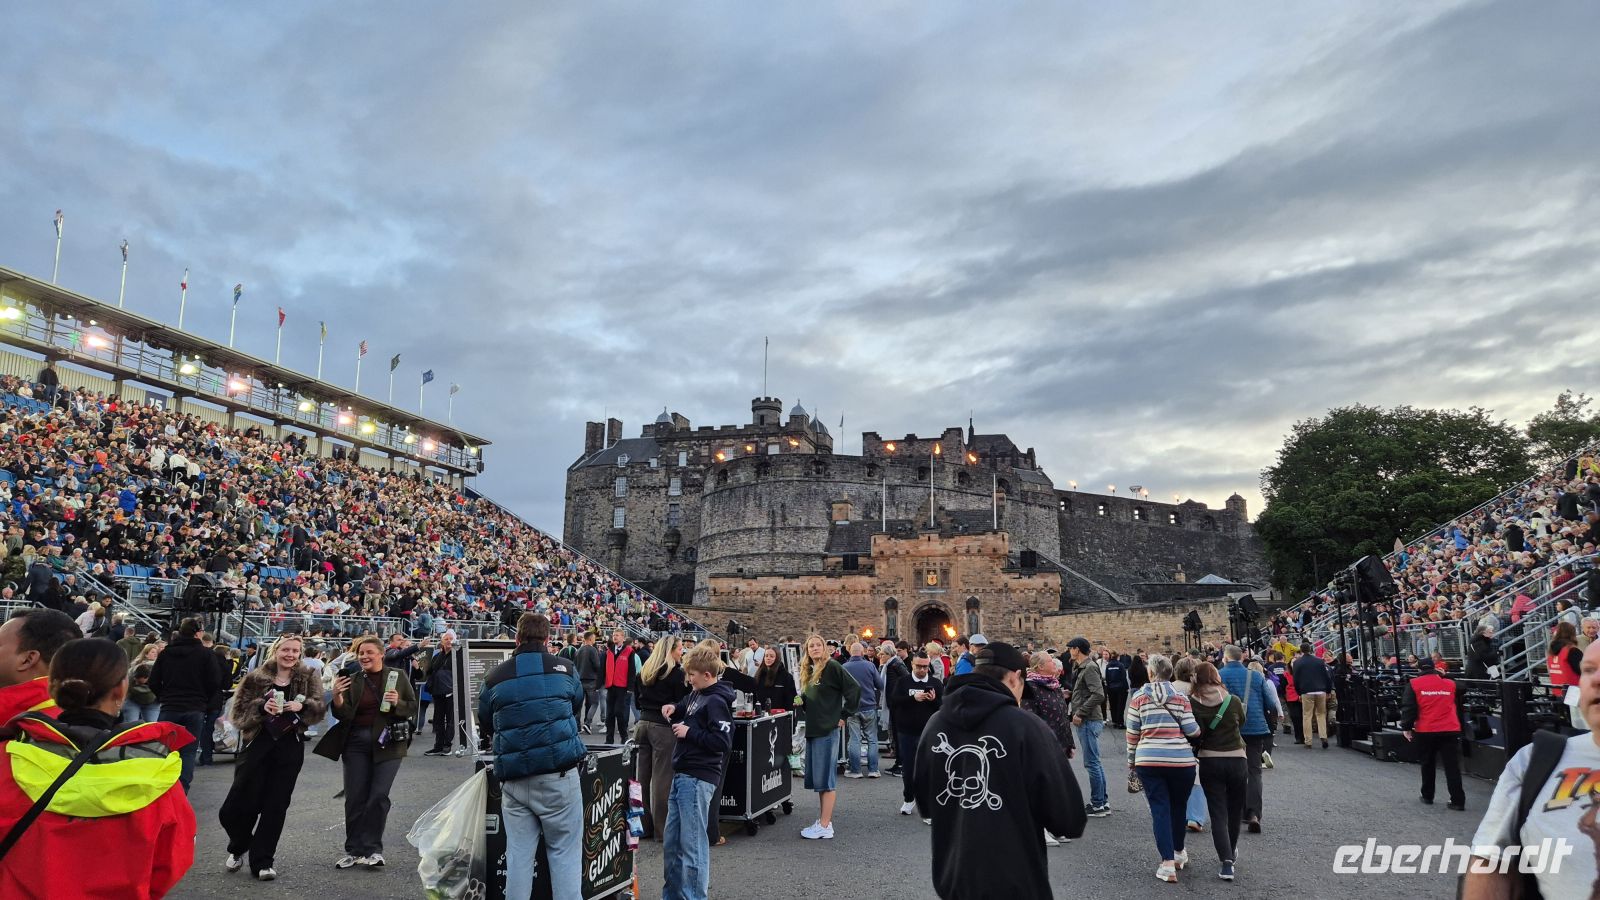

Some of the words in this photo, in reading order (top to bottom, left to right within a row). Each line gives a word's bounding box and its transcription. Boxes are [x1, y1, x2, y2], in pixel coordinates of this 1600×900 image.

[592, 778, 622, 824] INNIS
[602, 818, 611, 840] &
[589, 832, 620, 881] GUNN
